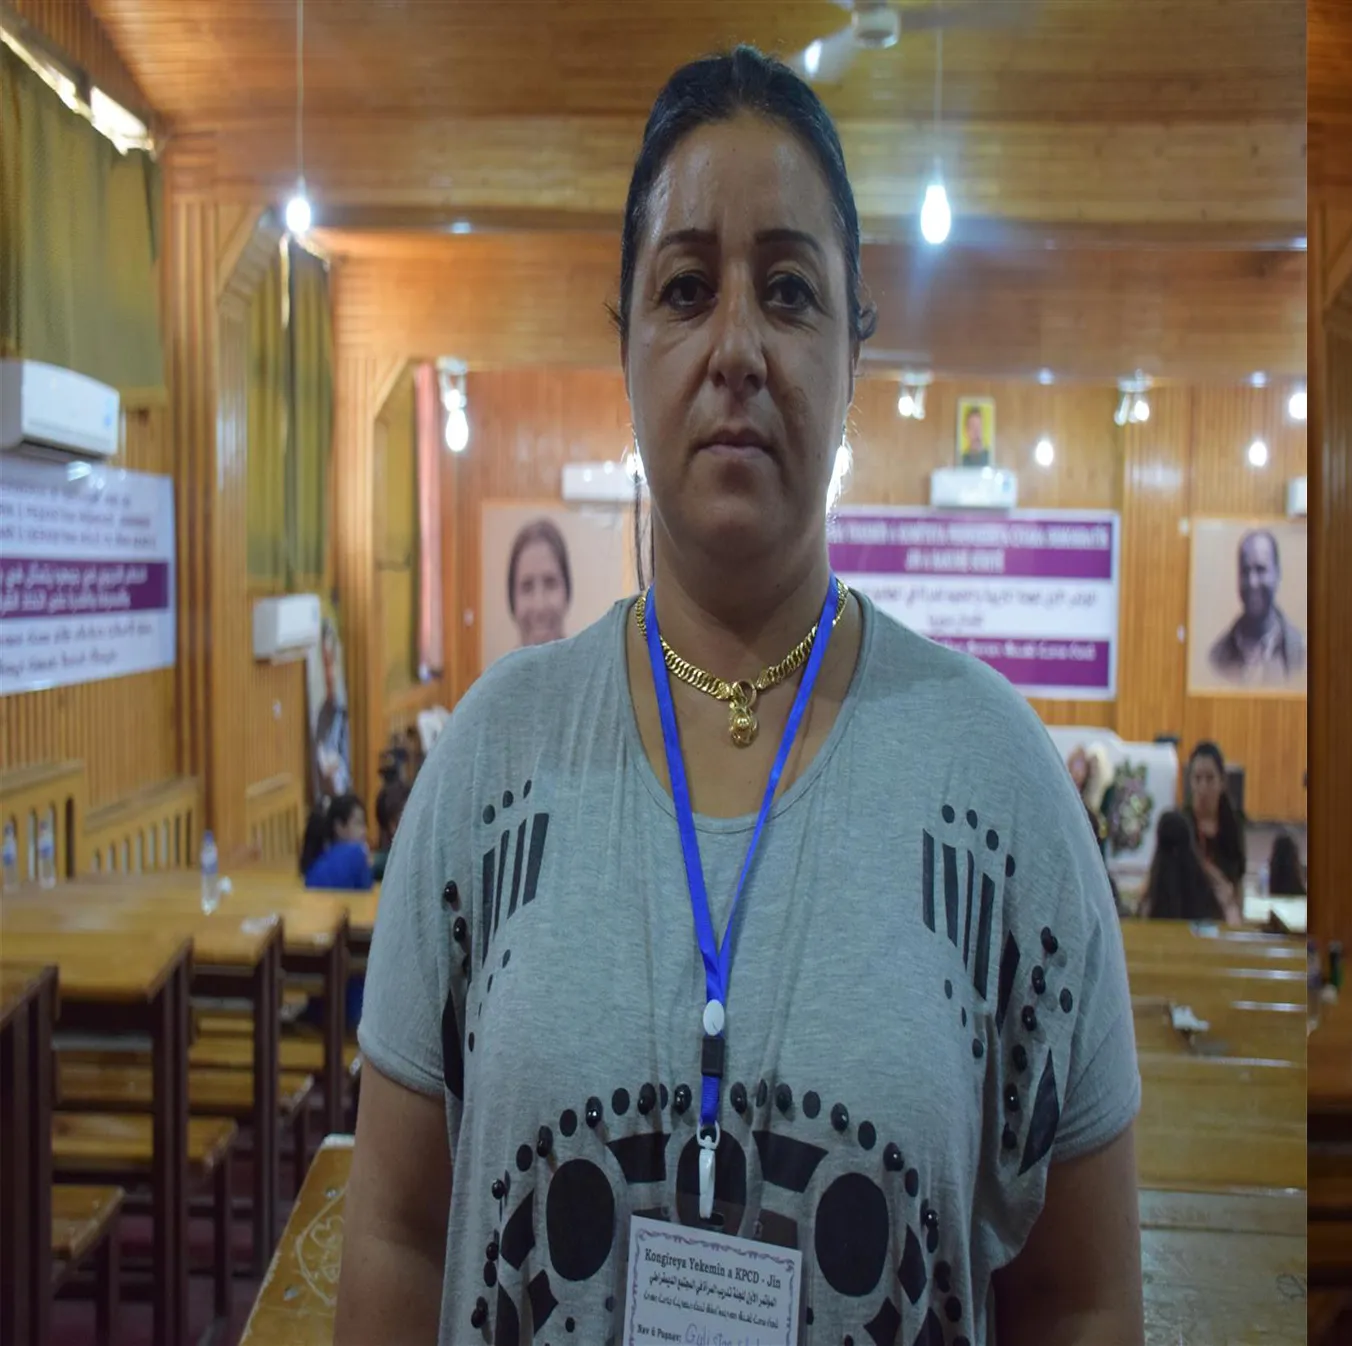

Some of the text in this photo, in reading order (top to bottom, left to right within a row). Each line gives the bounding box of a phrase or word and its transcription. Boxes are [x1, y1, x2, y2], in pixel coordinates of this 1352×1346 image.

[728, 1269, 733, 1279] a
[735, 1267, 760, 1285] KPCD
[767, 1274, 782, 1290] Jin
